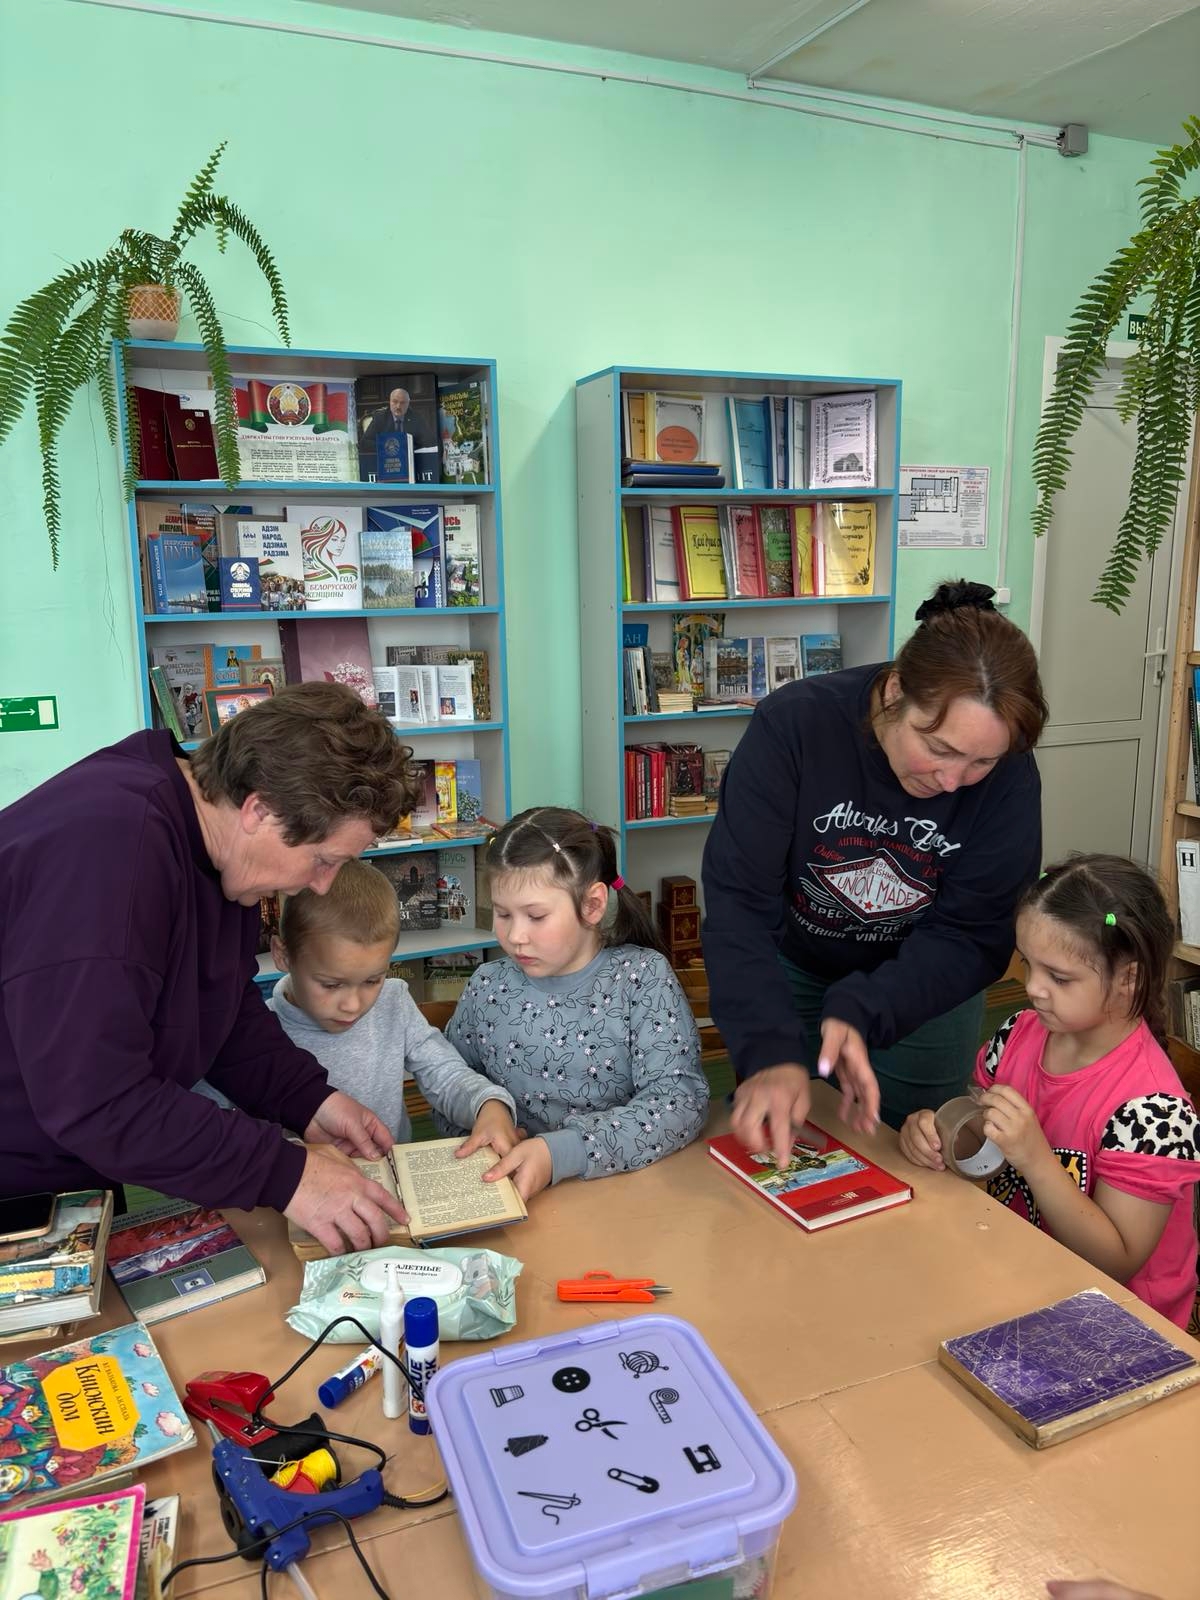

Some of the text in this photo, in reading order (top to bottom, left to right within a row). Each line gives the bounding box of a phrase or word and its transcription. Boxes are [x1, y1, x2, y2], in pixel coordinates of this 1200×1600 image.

[310, 583, 357, 591] БЕЛОРУССКОЙ
[876, 880, 914, 906] MADE
[384, 1263, 442, 1273] ТАЛЕТНЫЕ
[55, 1388, 81, 1422] дом
[75, 1363, 116, 1436] Книжкин
